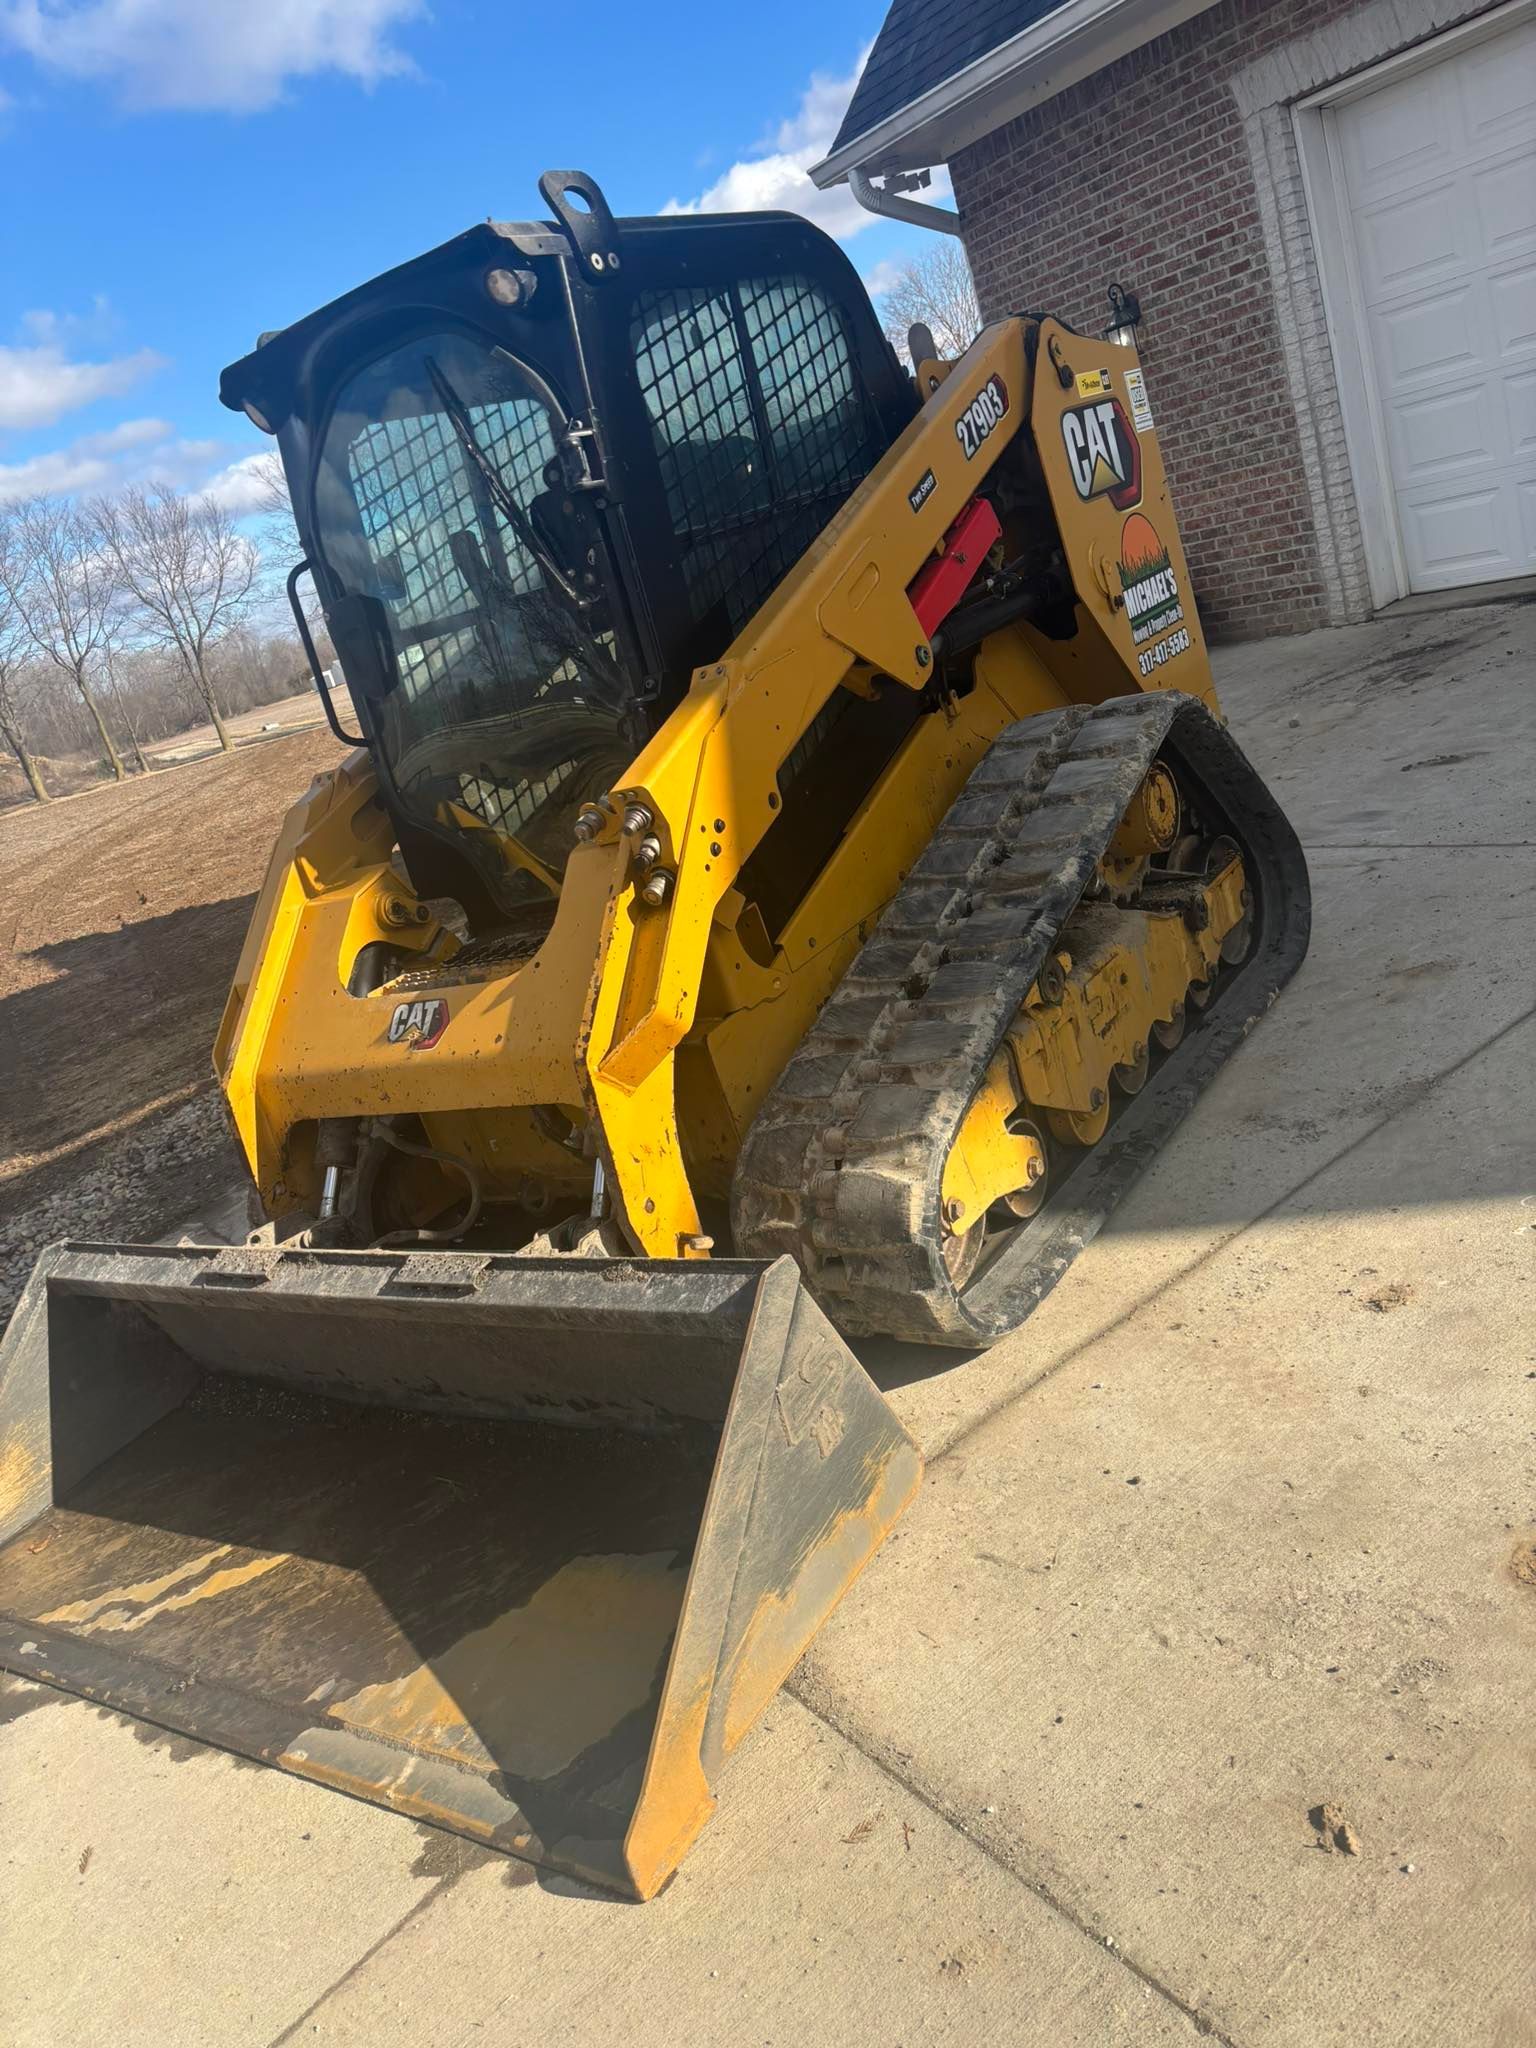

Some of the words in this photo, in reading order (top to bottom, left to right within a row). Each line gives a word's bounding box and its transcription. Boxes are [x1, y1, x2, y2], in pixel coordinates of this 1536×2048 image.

[956, 381, 1004, 459] 279D3
[1062, 402, 1126, 497] CAT
[1123, 567, 1178, 620] MICHAEL'S
[1138, 628, 1190, 676] 317-417-5583
[389, 1000, 440, 1042] CAT
